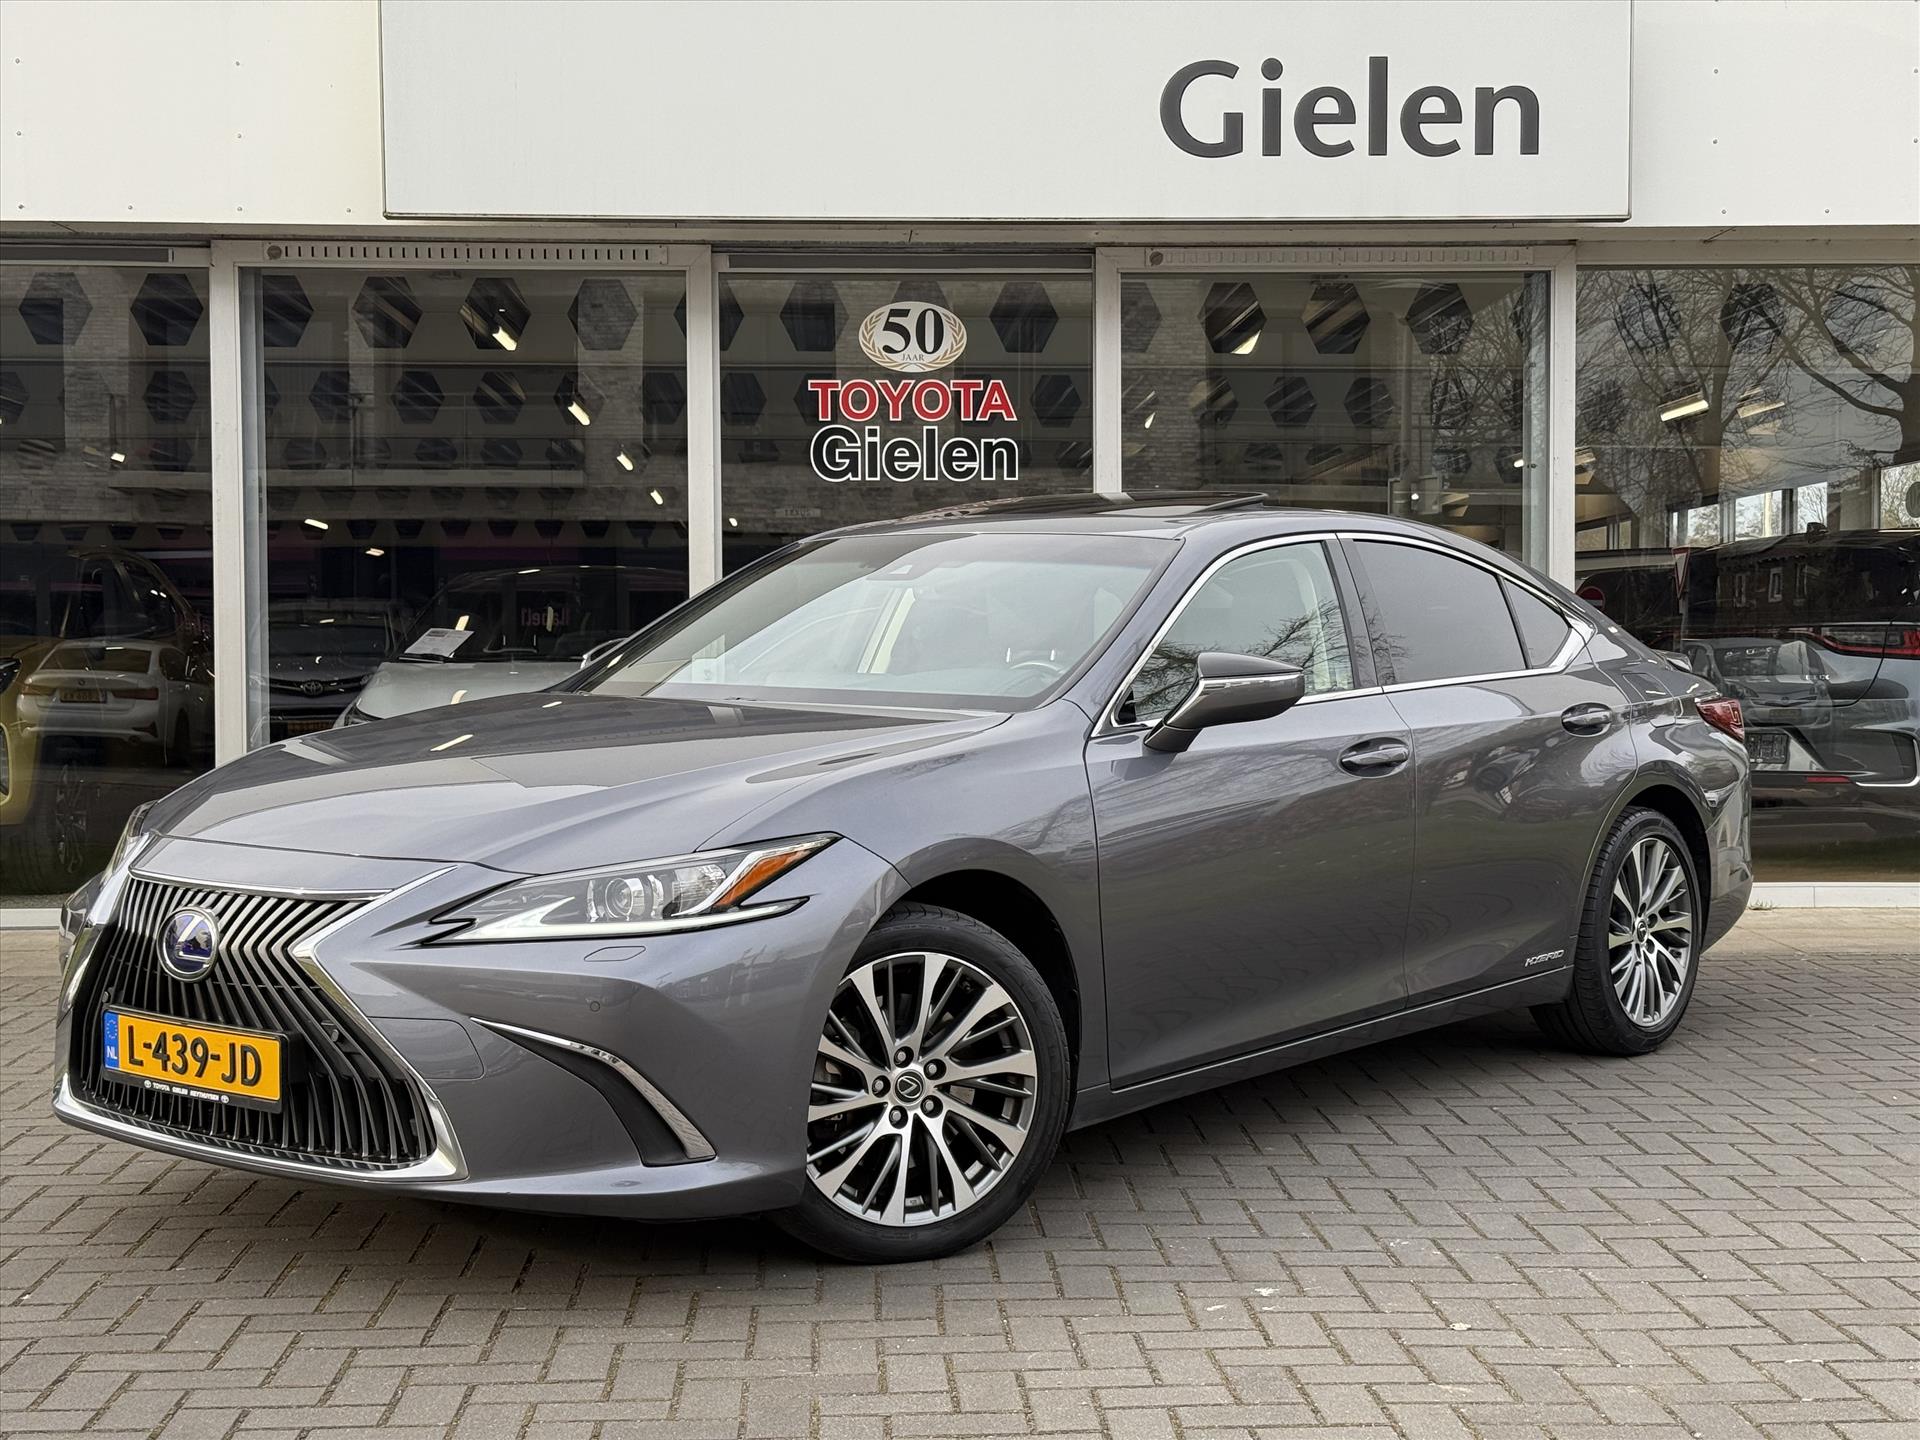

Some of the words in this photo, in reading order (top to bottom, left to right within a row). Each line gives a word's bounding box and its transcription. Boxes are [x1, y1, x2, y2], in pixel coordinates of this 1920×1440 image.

[1159, 55, 1540, 158] Gielen
[881, 307, 945, 355] 50
[901, 353, 925, 362] JAAR
[808, 379, 1018, 422] TOYOTA
[810, 424, 1019, 482] Gielen
[106, 1045, 118, 1060] NL
[127, 1025, 262, 1087] L-439-JD
